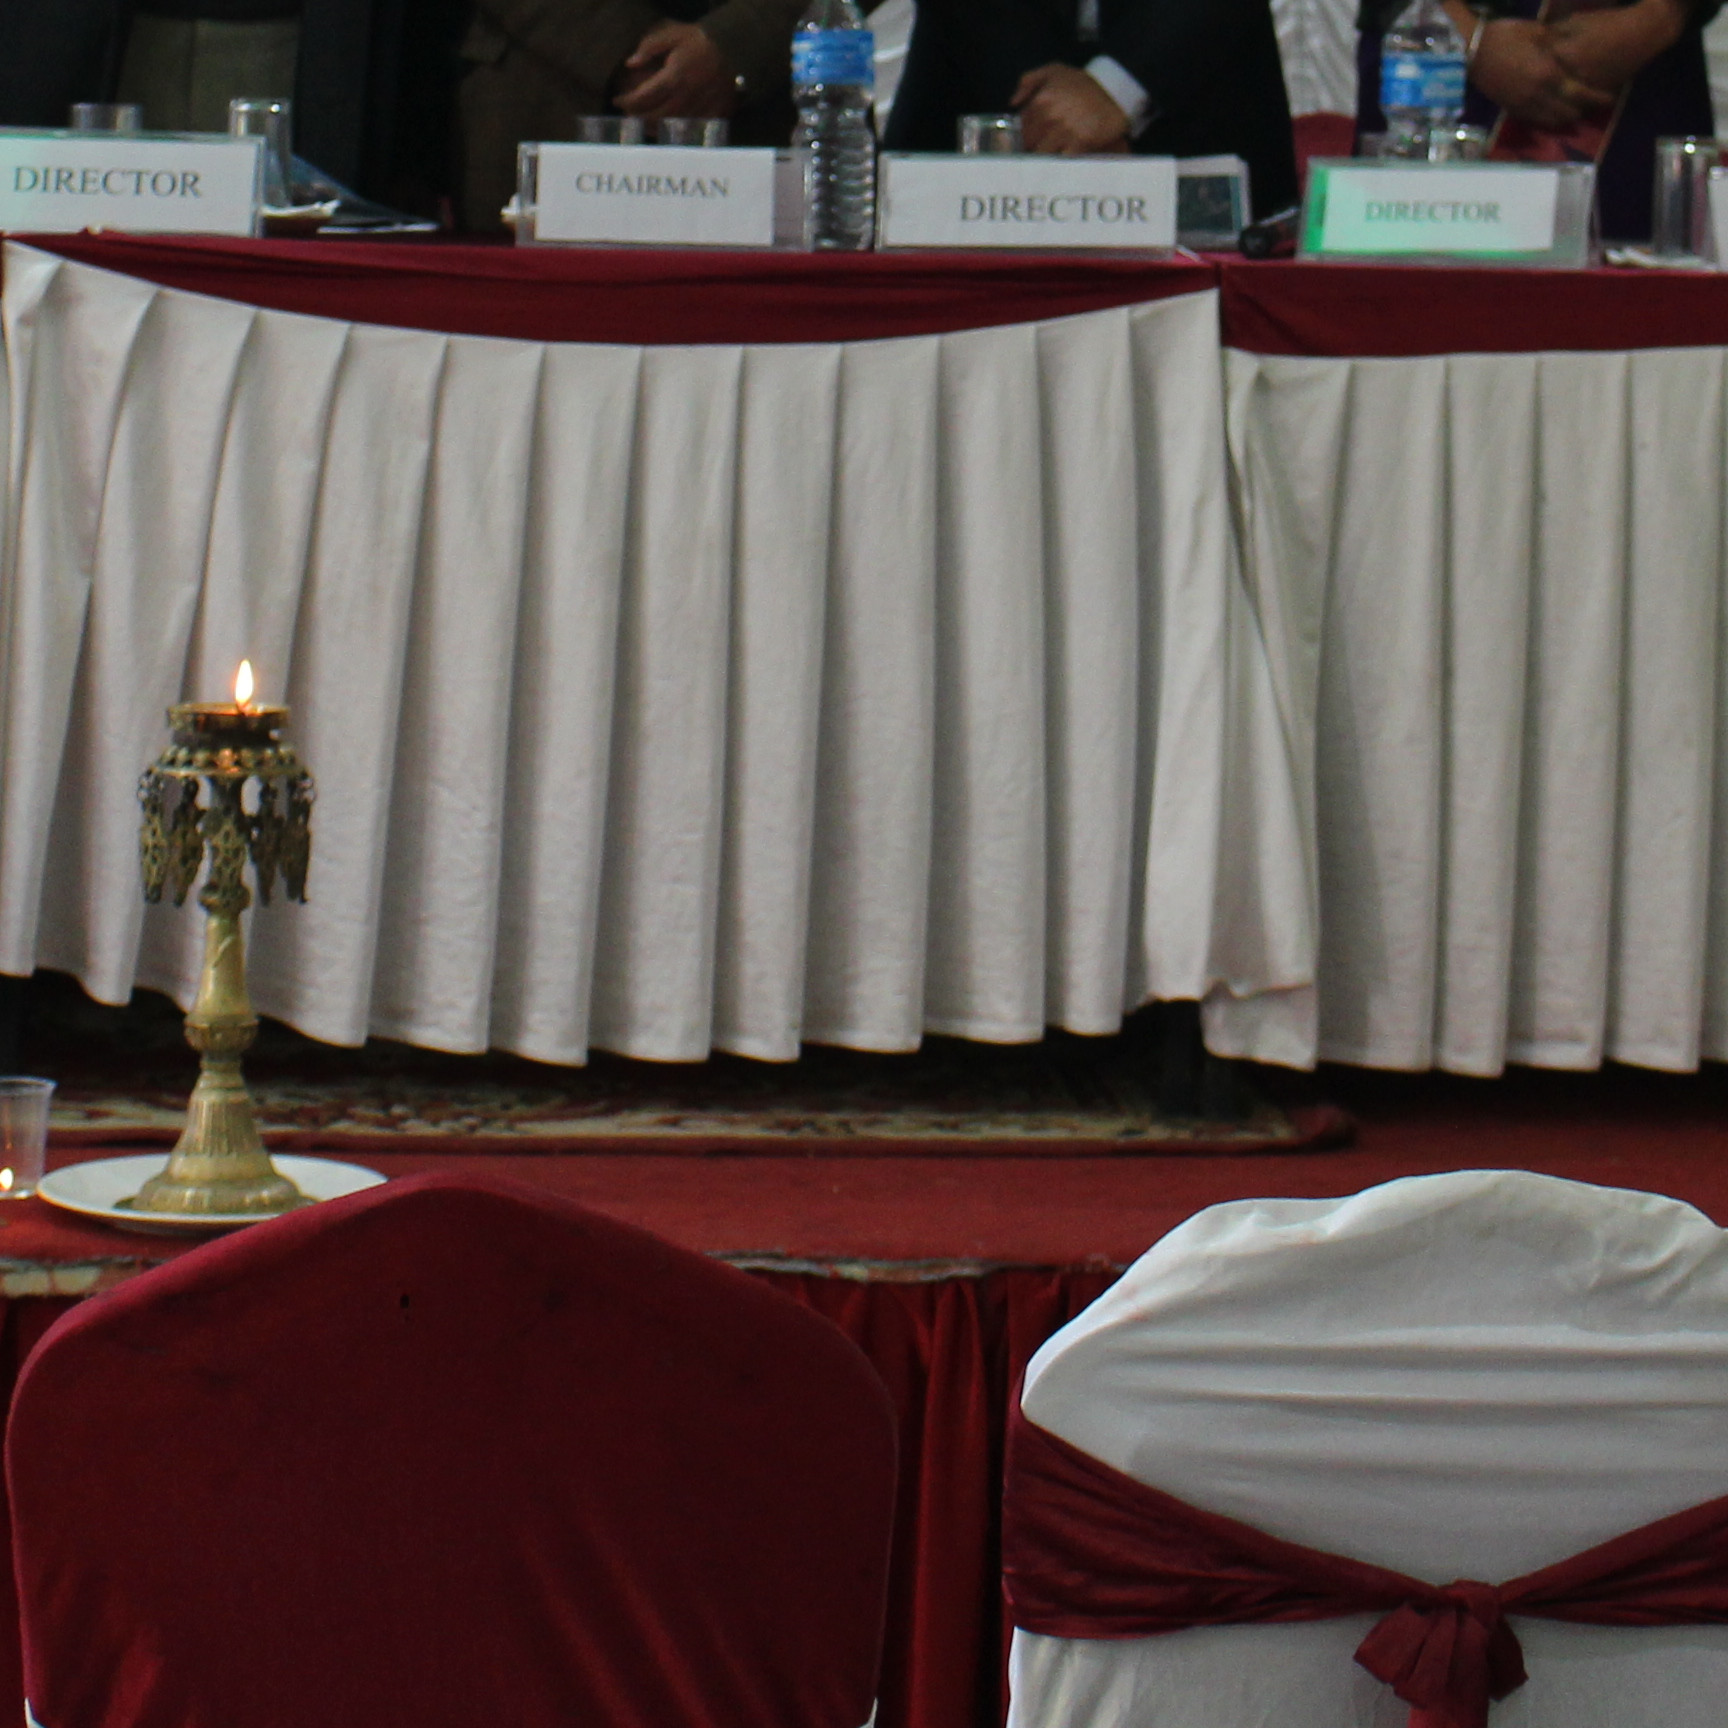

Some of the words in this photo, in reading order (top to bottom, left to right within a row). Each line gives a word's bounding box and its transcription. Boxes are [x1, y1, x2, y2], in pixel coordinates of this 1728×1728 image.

[11, 164, 203, 199] DIRECTOR
[574, 171, 730, 199] CHAIRMAN
[958, 192, 1148, 225] DIRECTOR
[1365, 200, 1503, 224] DIRECTOR
